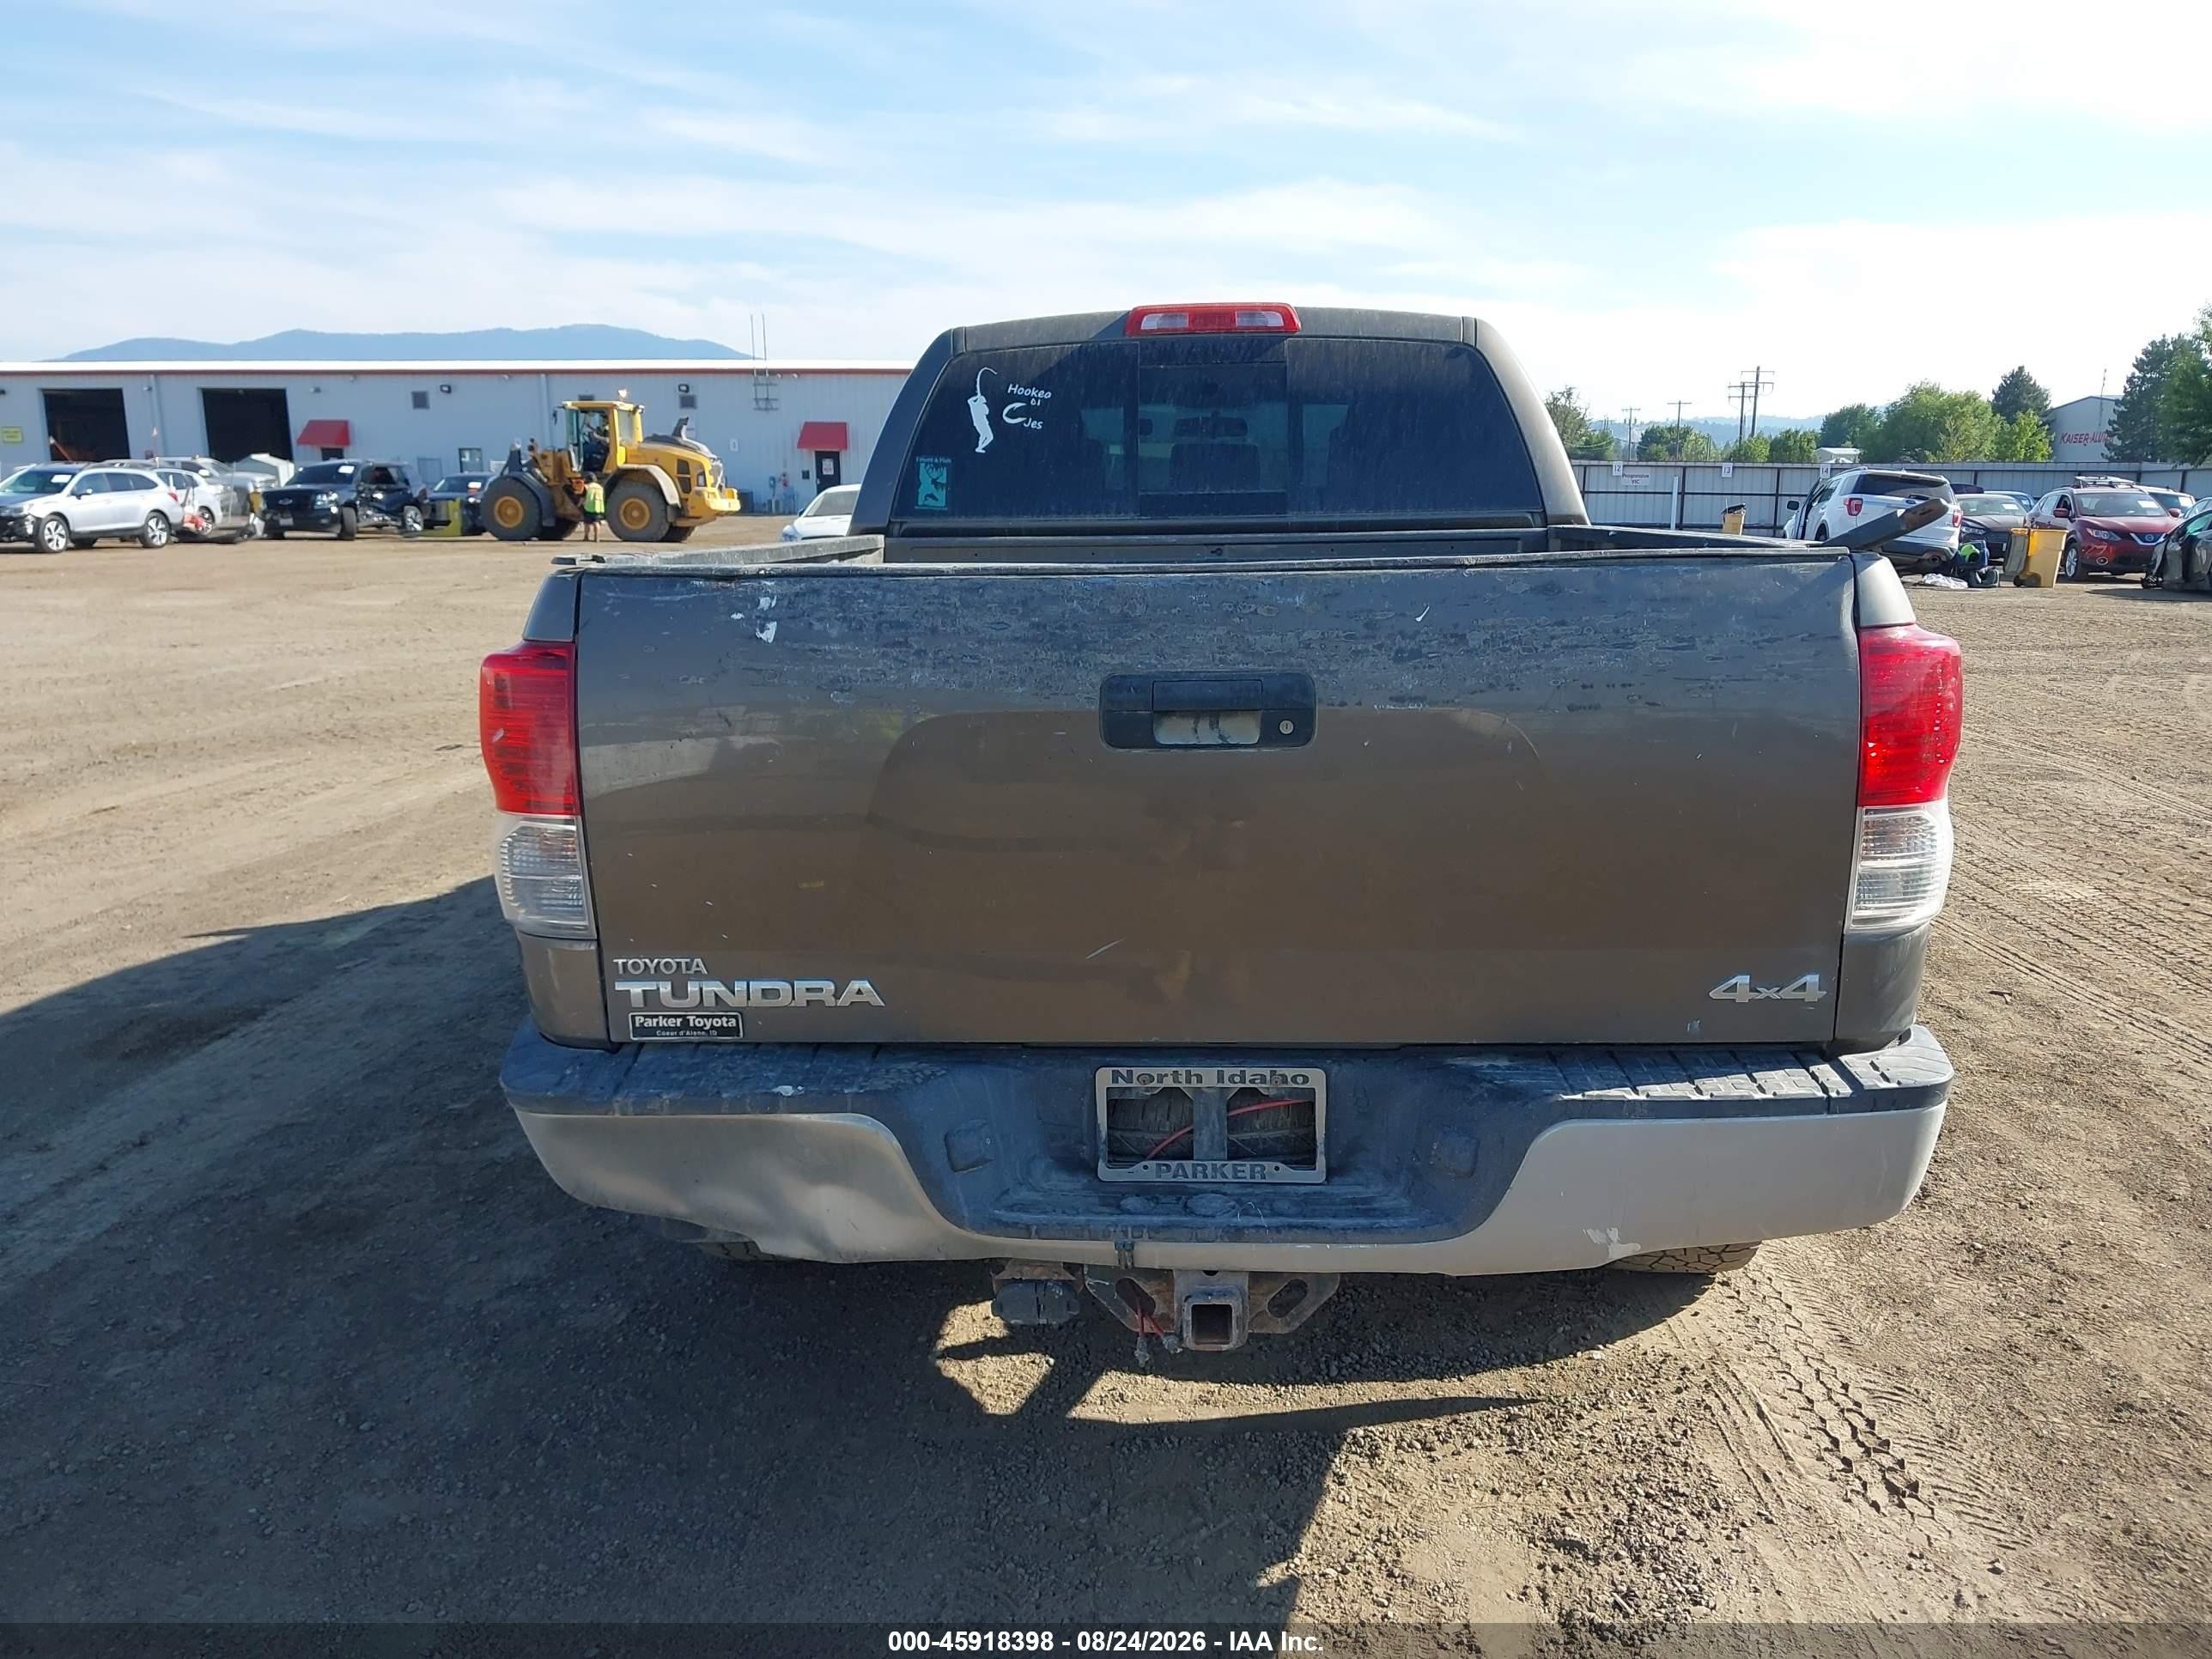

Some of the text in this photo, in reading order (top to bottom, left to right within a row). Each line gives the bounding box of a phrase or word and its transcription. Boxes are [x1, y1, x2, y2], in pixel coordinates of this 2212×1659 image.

[2061, 432, 2088, 444] KAISER
[612, 957, 708, 975] TOYOTA
[614, 980, 885, 1008] TUNDRA
[635, 1015, 737, 1030] Parker Toyota
[1110, 1069, 1310, 1085] North Idaho
[1154, 1163, 1267, 1181] PARKER
